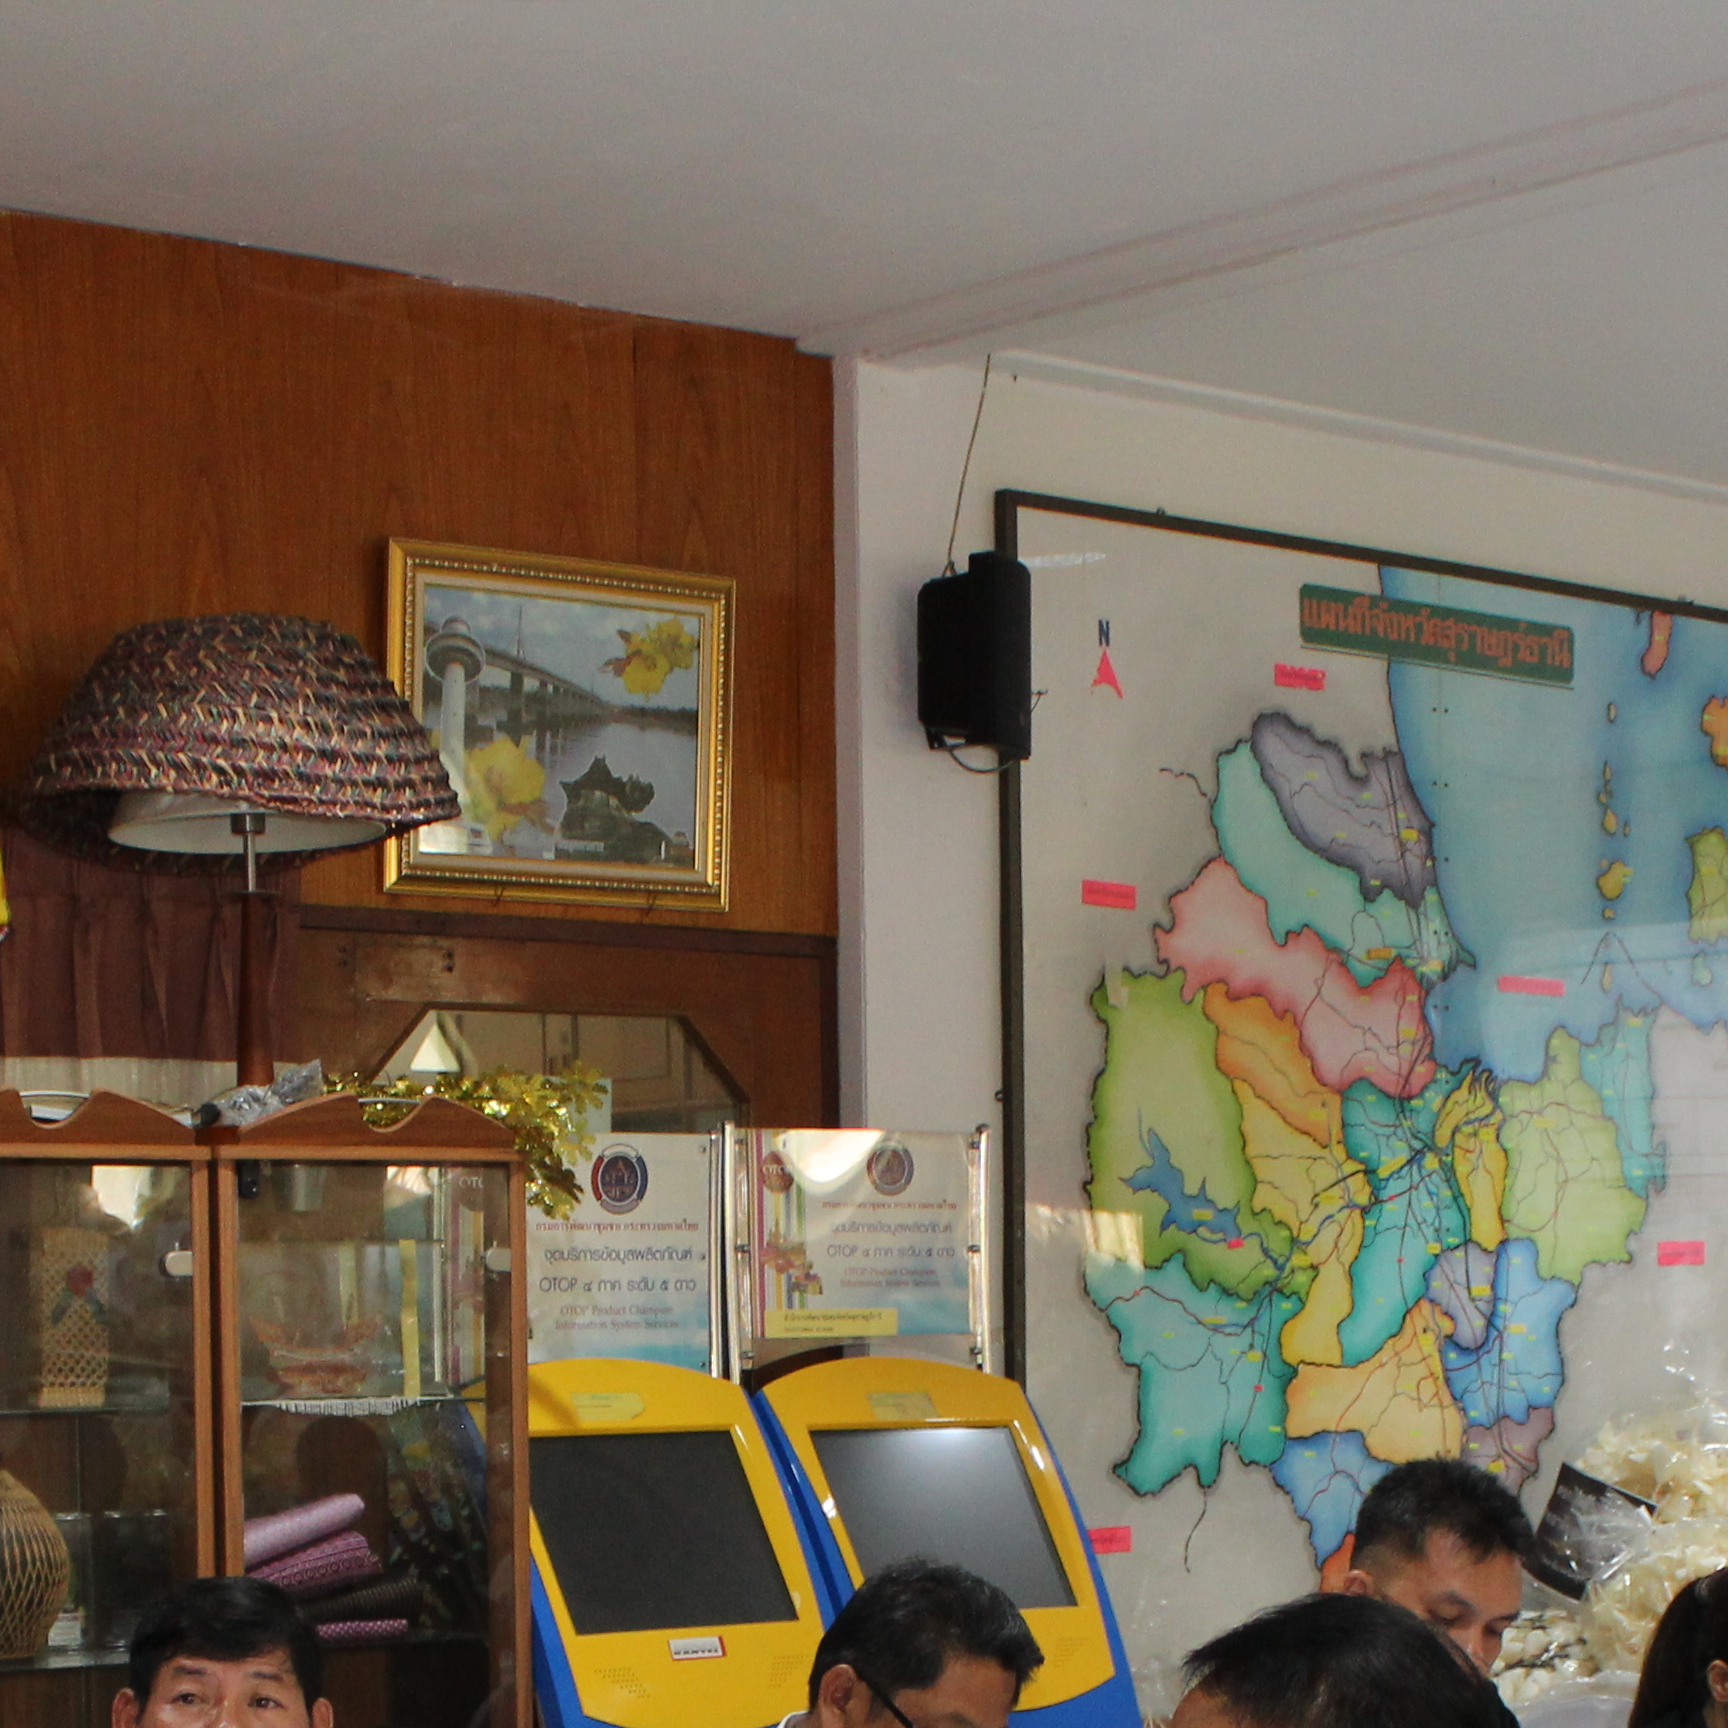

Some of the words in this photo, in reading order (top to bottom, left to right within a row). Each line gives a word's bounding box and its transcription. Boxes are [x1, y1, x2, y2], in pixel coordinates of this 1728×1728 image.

[1098, 619, 1111, 648] N
[827, 1245, 858, 1258] OTOP
[539, 1276, 578, 1292] OTOP
